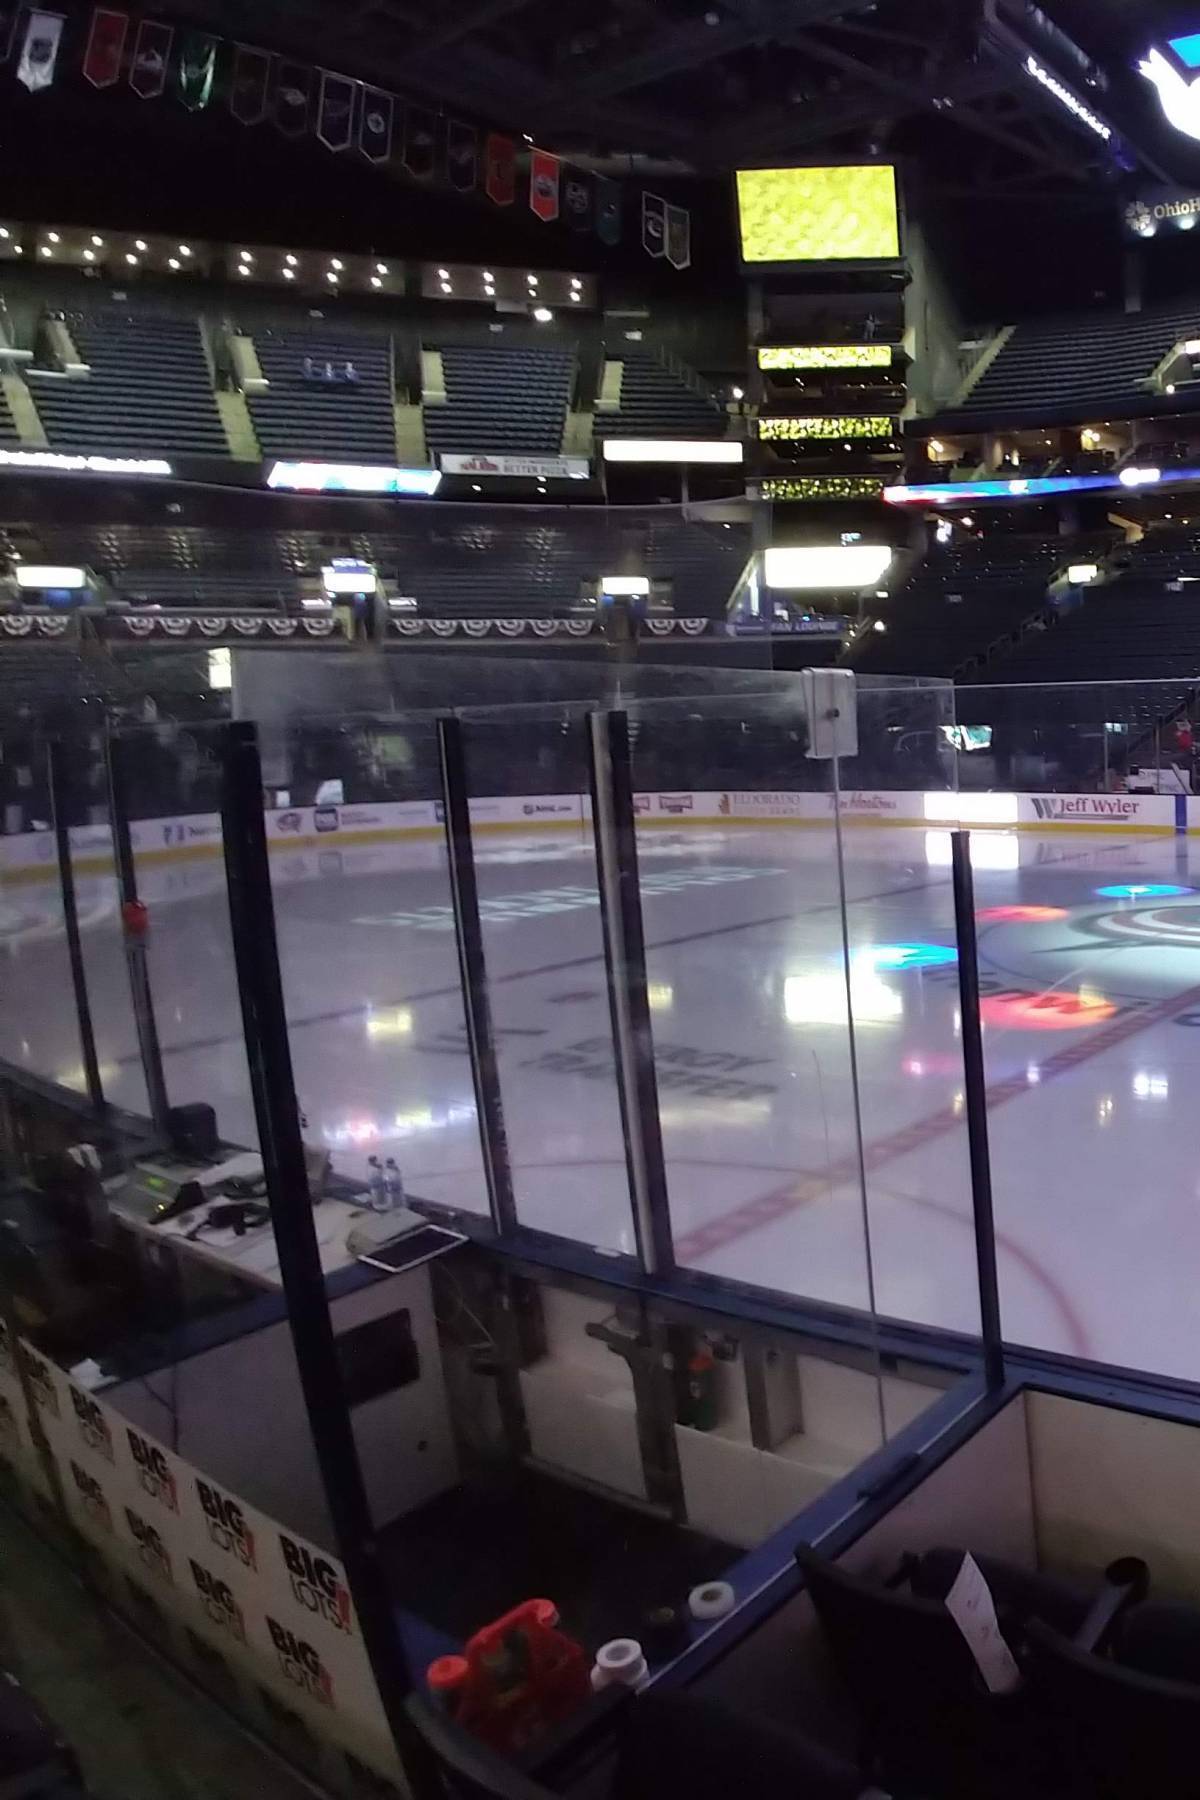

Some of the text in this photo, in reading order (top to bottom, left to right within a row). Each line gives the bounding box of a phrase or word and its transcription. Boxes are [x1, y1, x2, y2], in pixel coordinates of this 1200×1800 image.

[1059, 798, 1088, 813] Jeff
[1092, 799, 1139, 814] Wyler
[127, 1427, 170, 1482] BIG
[196, 1478, 244, 1538] BIG
[188, 1557, 236, 1615] BIG
[279, 1534, 338, 1598] BIG
[265, 1614, 321, 1677] BIG
